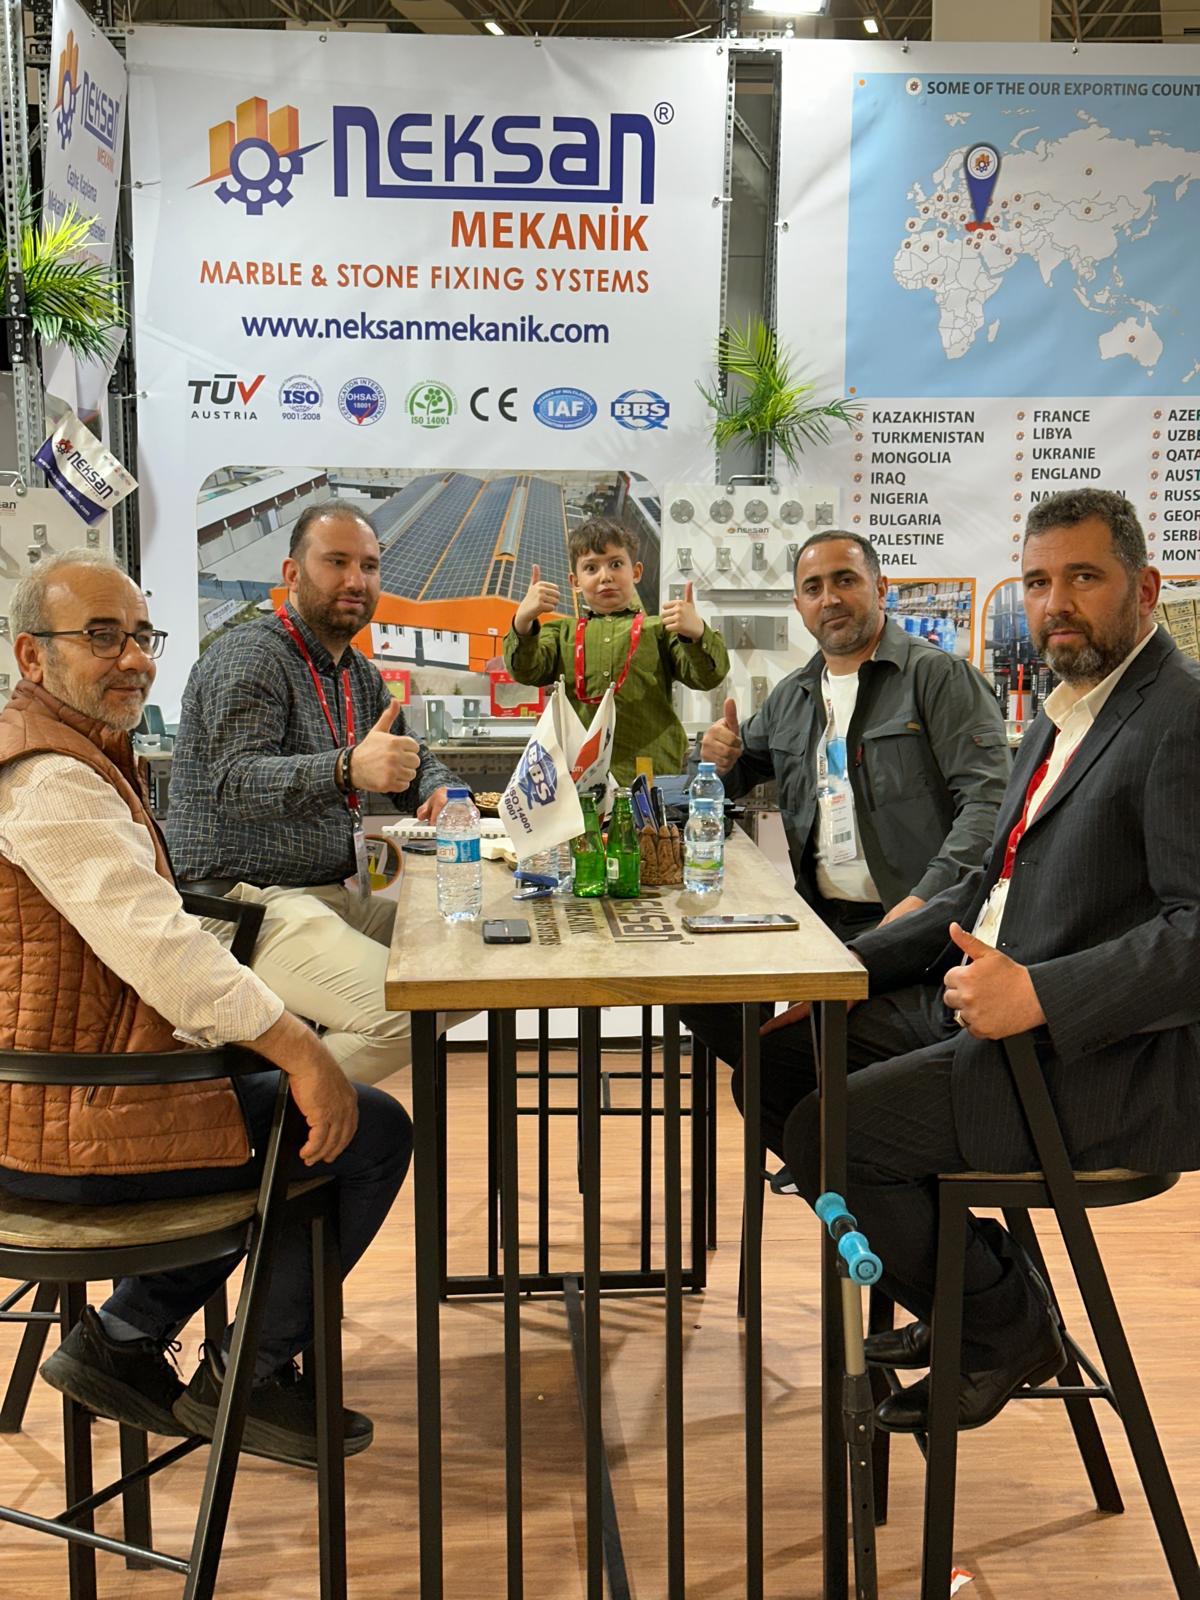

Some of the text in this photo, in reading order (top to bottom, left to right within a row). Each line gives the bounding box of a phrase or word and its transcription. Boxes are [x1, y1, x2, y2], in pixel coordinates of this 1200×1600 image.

[927, 81, 970, 95] SOME
[974, 81, 993, 95] OF
[997, 82, 1025, 95] THE
[1028, 82, 1060, 96] OUR
[1064, 83, 1148, 96] EXPORTING
[451, 205, 649, 251] MEKANİK
[200, 260, 649, 293] MARBLE & STONE FIXING SYSTEMS
[242, 312, 609, 343] www.neksanmekanik.com
[283, 390, 320, 404] ISO
[347, 393, 378, 401] OHSAS
[470, 387, 518, 422] CE
[548, 400, 584, 417] IAF
[614, 402, 667, 417] BBS
[191, 411, 258, 420] AUSTRIA
[282, 412, 321, 421] 9001:2008
[411, 416, 450, 425] ISO 14001
[872, 411, 975, 424] KAZAKHISTAN
[1033, 410, 1091, 422] FRANCE
[872, 431, 985, 444] TURKMENISTAN
[1033, 428, 1073, 440] LIBYA
[871, 452, 952, 464] MONGOLIA
[1032, 448, 1096, 460] UKRANIE
[870, 472, 906, 485] IRAQ
[1031, 467, 1102, 480] ENGLAND
[870, 493, 929, 505] NIGERIA
[869, 513, 942, 526] BULGARIA
[869, 533, 945, 546] PALESTINE
[517, 806, 534, 834] 14001
